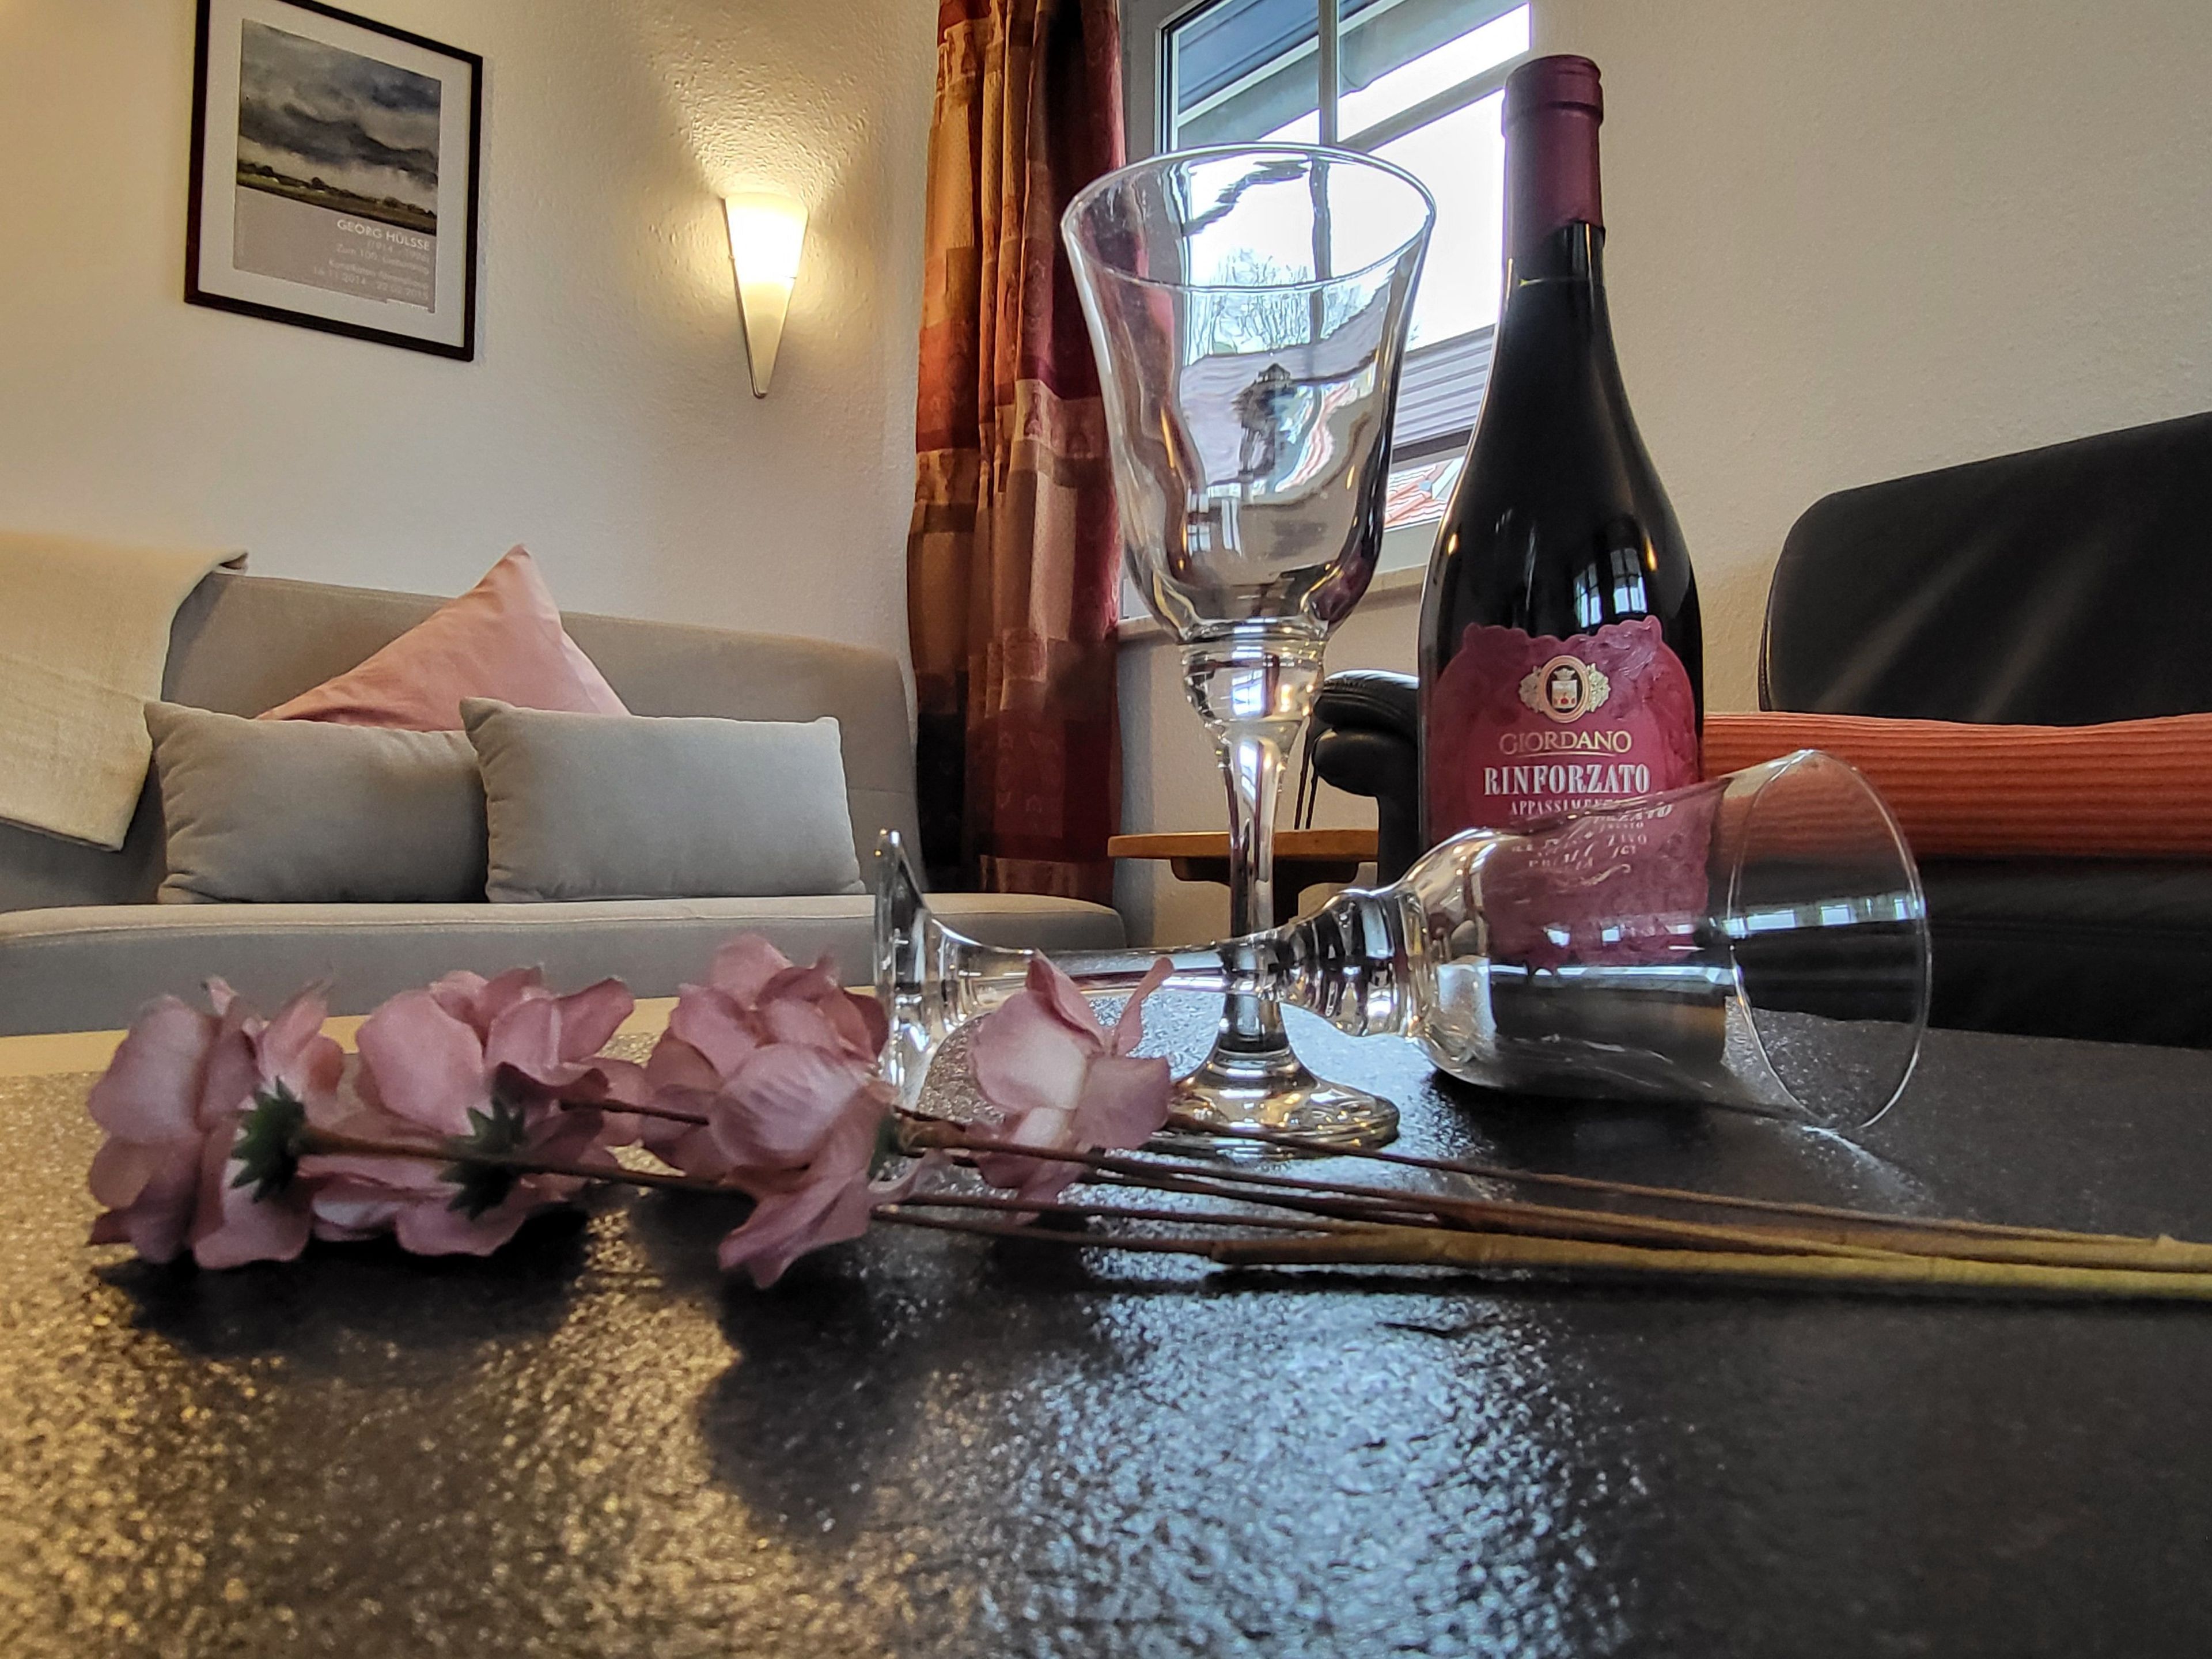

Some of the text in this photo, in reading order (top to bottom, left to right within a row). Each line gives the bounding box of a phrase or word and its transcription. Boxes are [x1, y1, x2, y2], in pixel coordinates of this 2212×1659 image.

[337, 219, 382, 237] GEORG
[1499, 730, 1631, 755] GIORDANO
[1484, 763, 1650, 796] RINFORZATO
